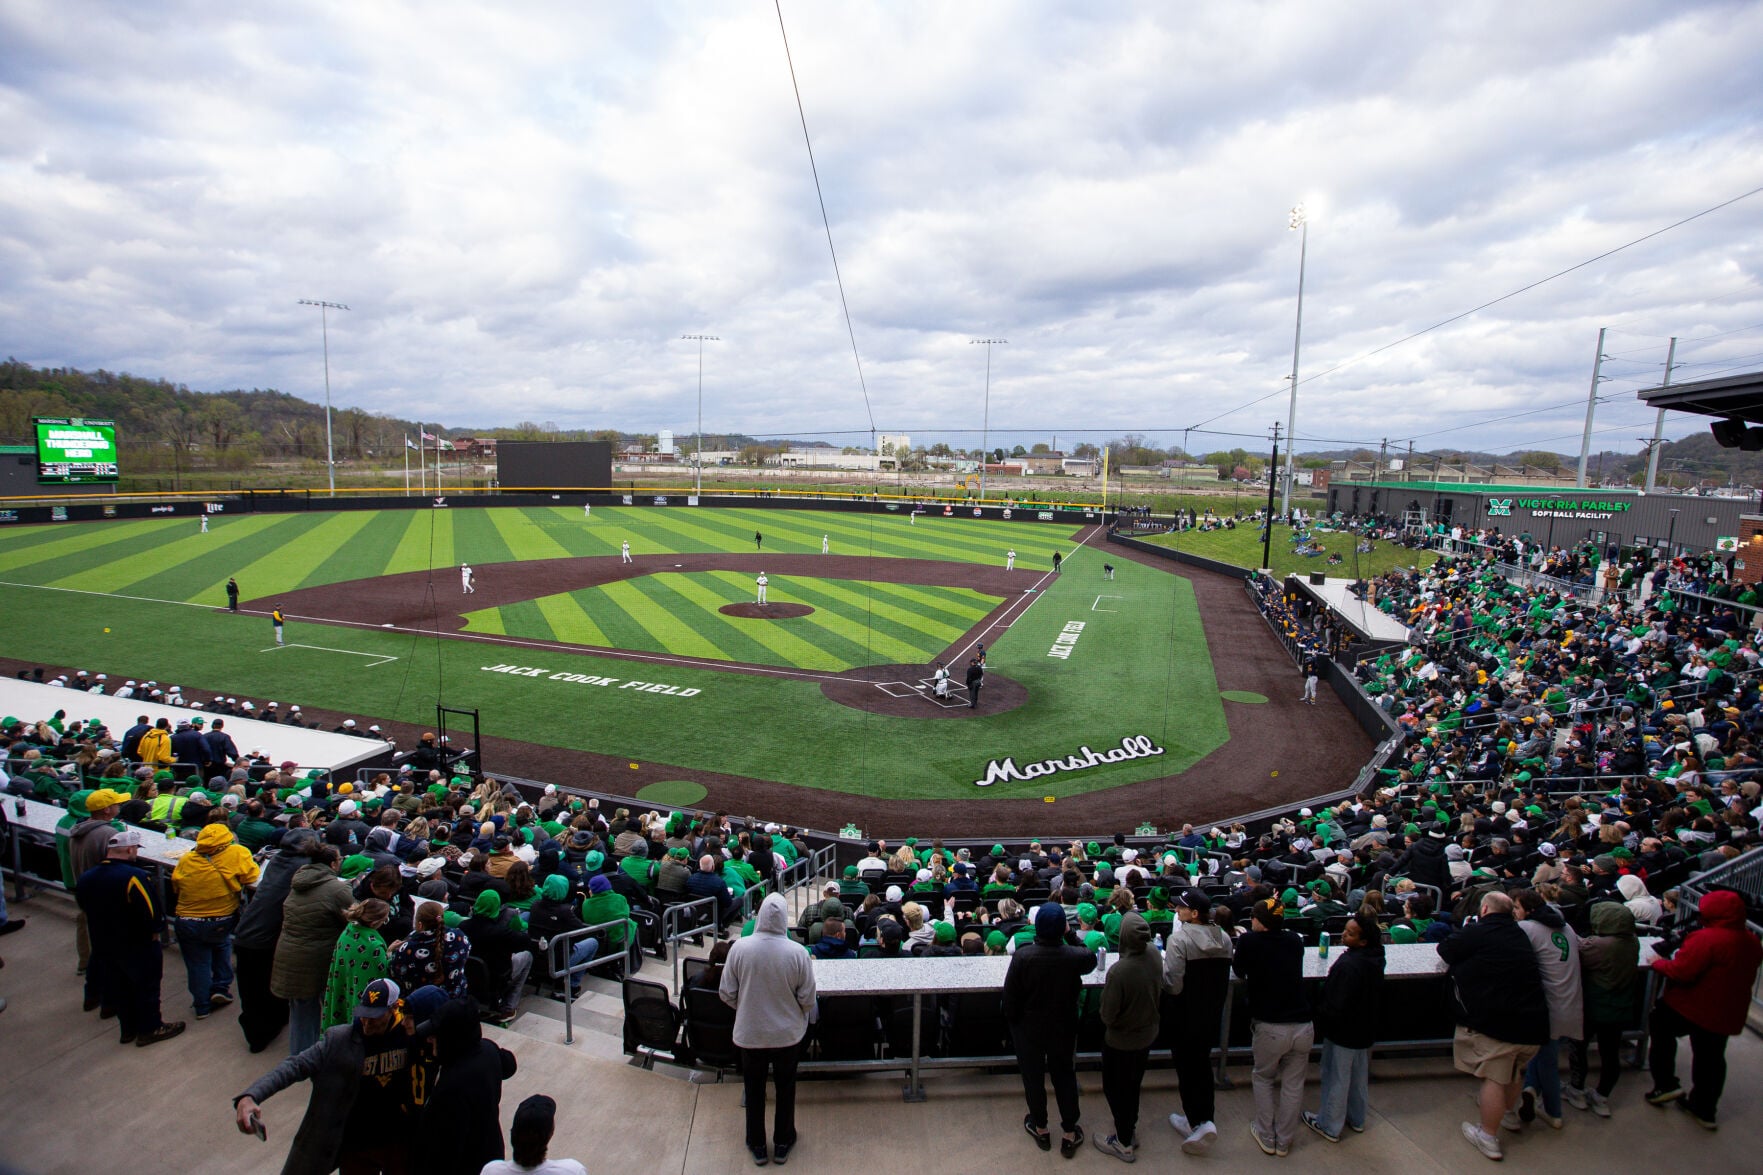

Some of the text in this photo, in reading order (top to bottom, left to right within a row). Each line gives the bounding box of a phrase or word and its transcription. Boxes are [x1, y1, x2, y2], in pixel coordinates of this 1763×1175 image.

[1517, 499, 1578, 510] VICTORIA
[1581, 501, 1632, 512] PARLEY
[1531, 510, 1613, 520] SOFTBALL FACILITY
[481, 664, 702, 697] JACK COOK FIELD
[974, 734, 1165, 786] Marshall
[1551, 931, 1569, 962] 9
